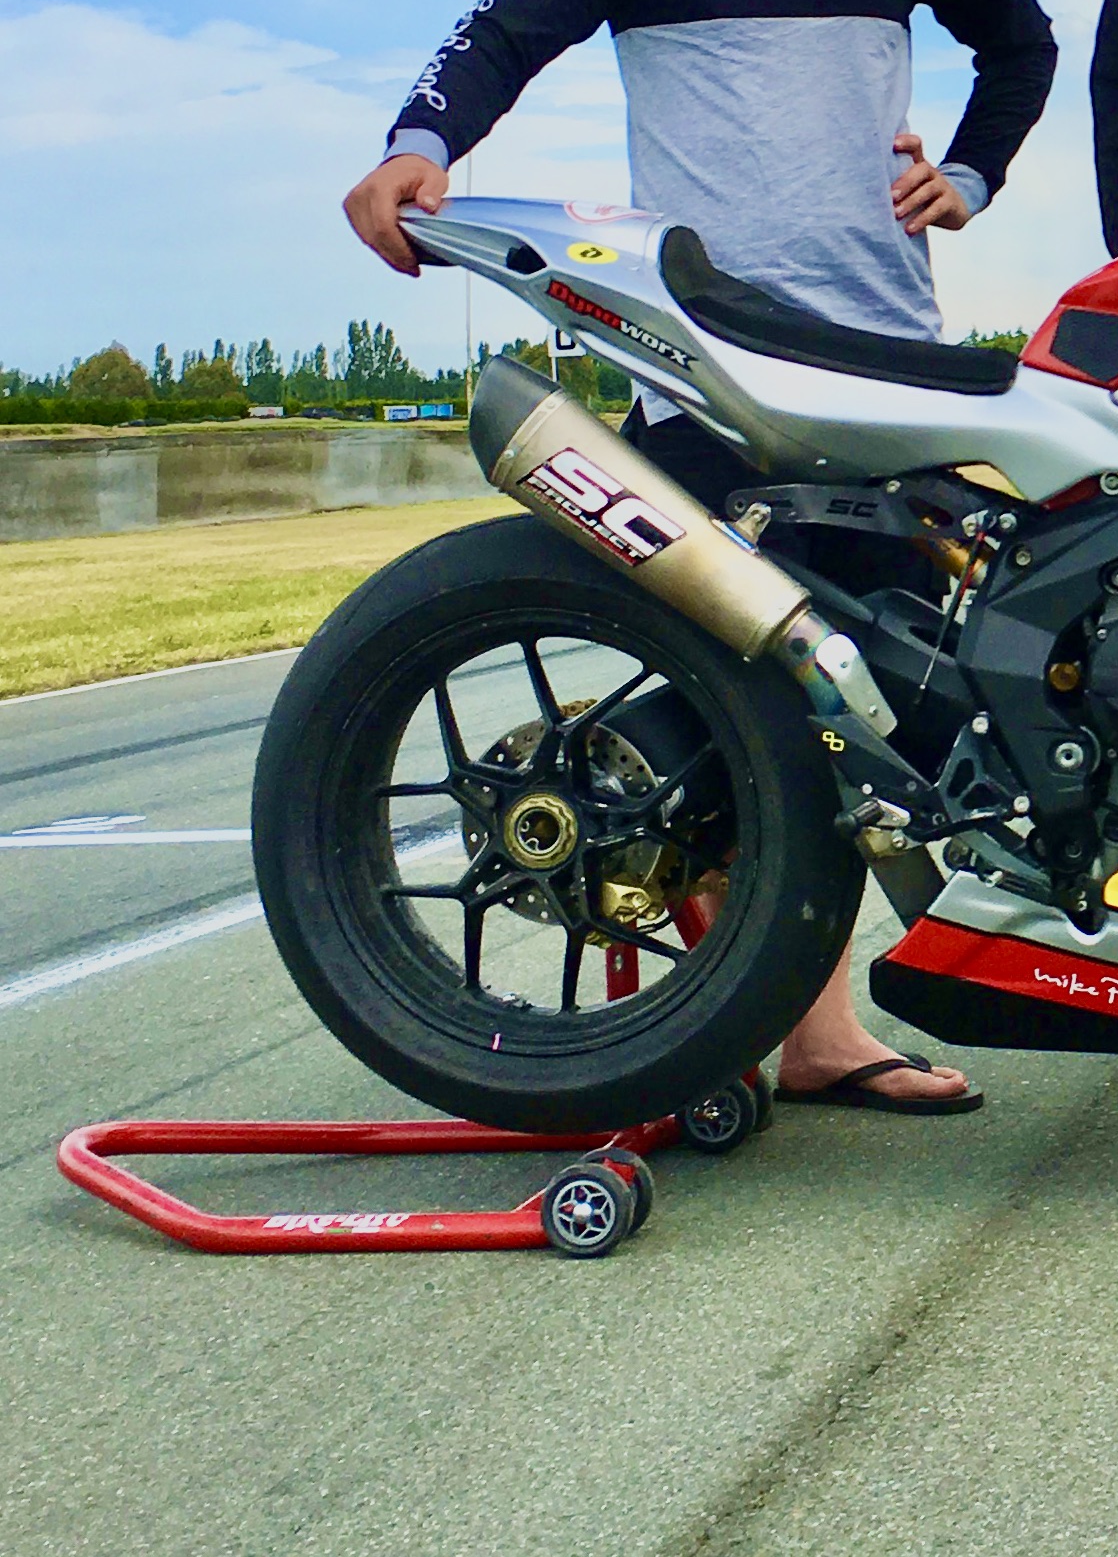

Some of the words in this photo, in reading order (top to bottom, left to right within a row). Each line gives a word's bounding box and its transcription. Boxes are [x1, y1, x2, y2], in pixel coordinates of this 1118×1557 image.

[527, 476, 645, 559] PROJECT
[532, 450, 686, 557] SC
[826, 498, 878, 518] SC
